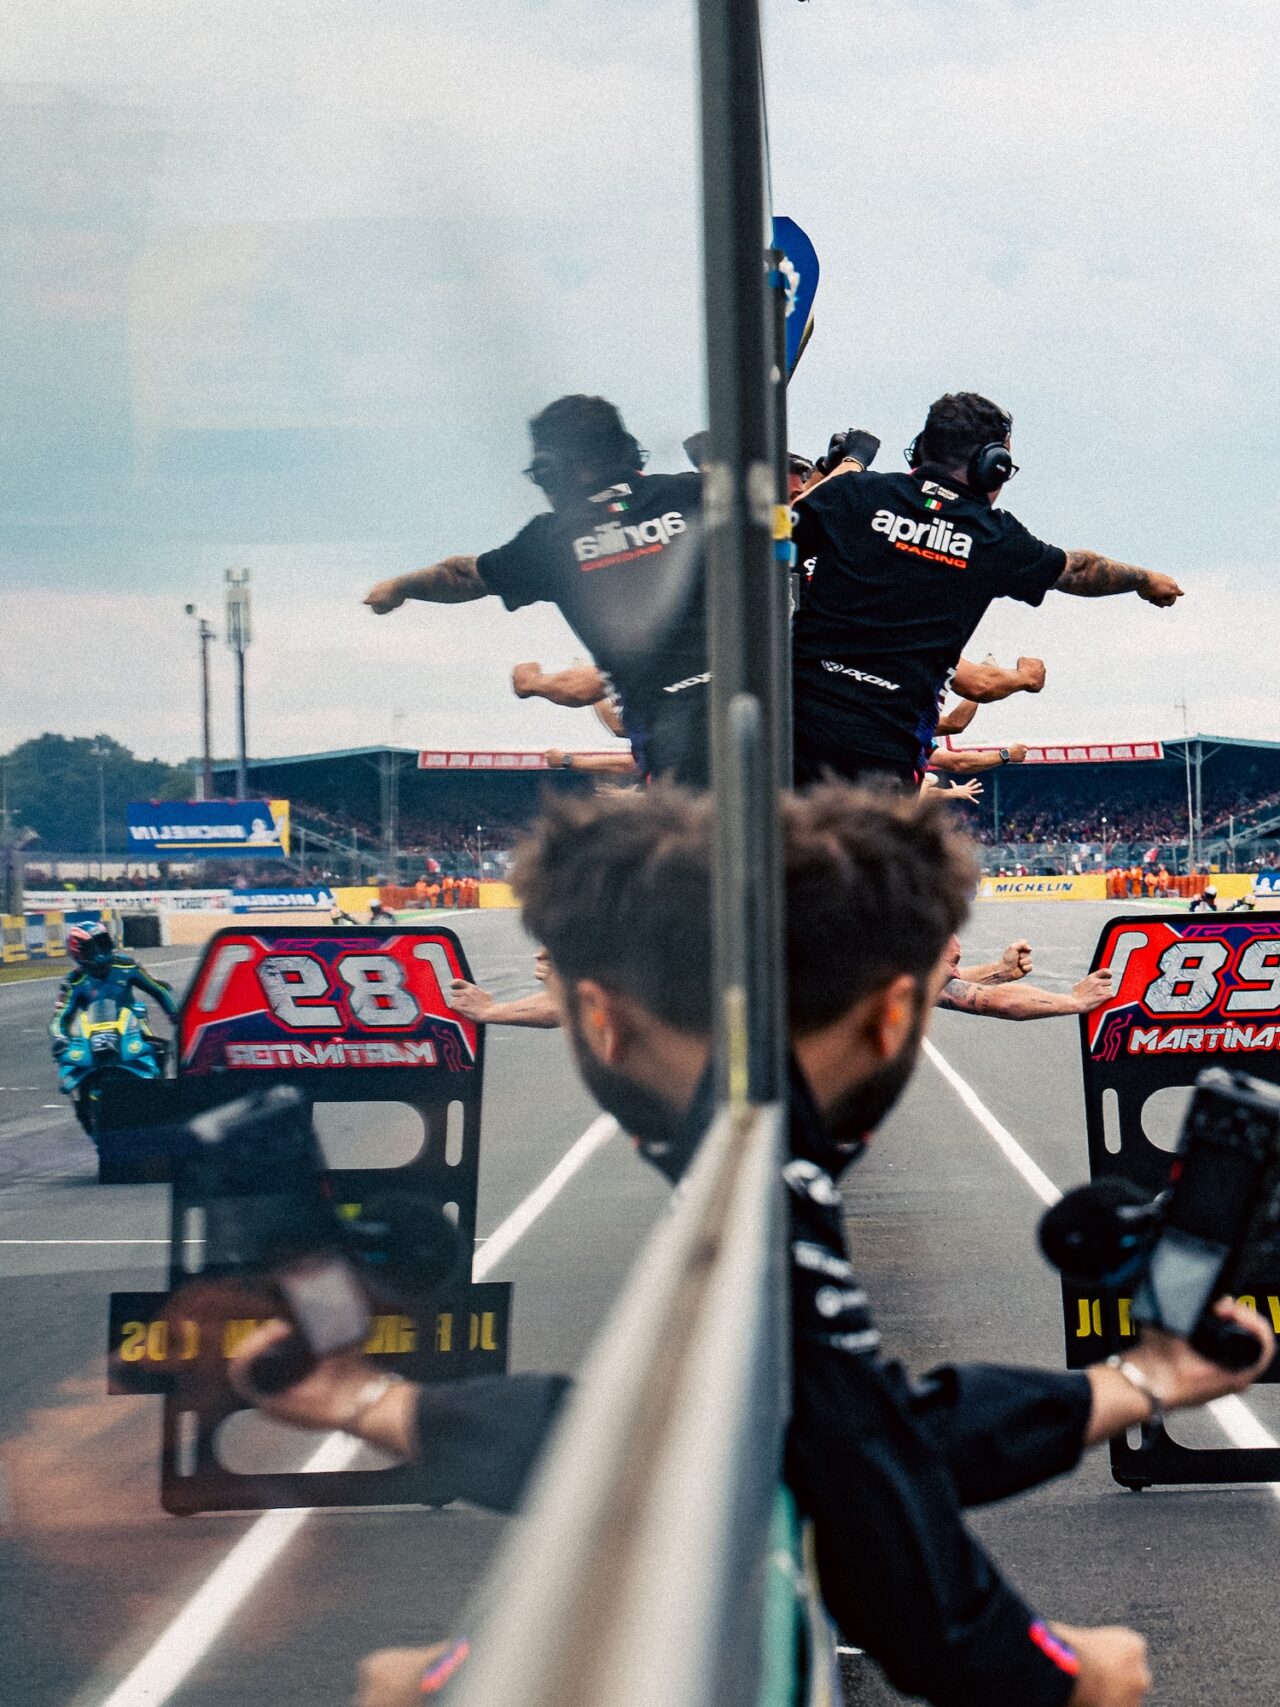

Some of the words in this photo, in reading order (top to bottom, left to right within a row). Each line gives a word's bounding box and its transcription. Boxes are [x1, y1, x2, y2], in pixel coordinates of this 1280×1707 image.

[871, 509, 973, 559] aprilia
[895, 541, 968, 569] RACING
[995, 882, 1073, 892] MICHELIN
